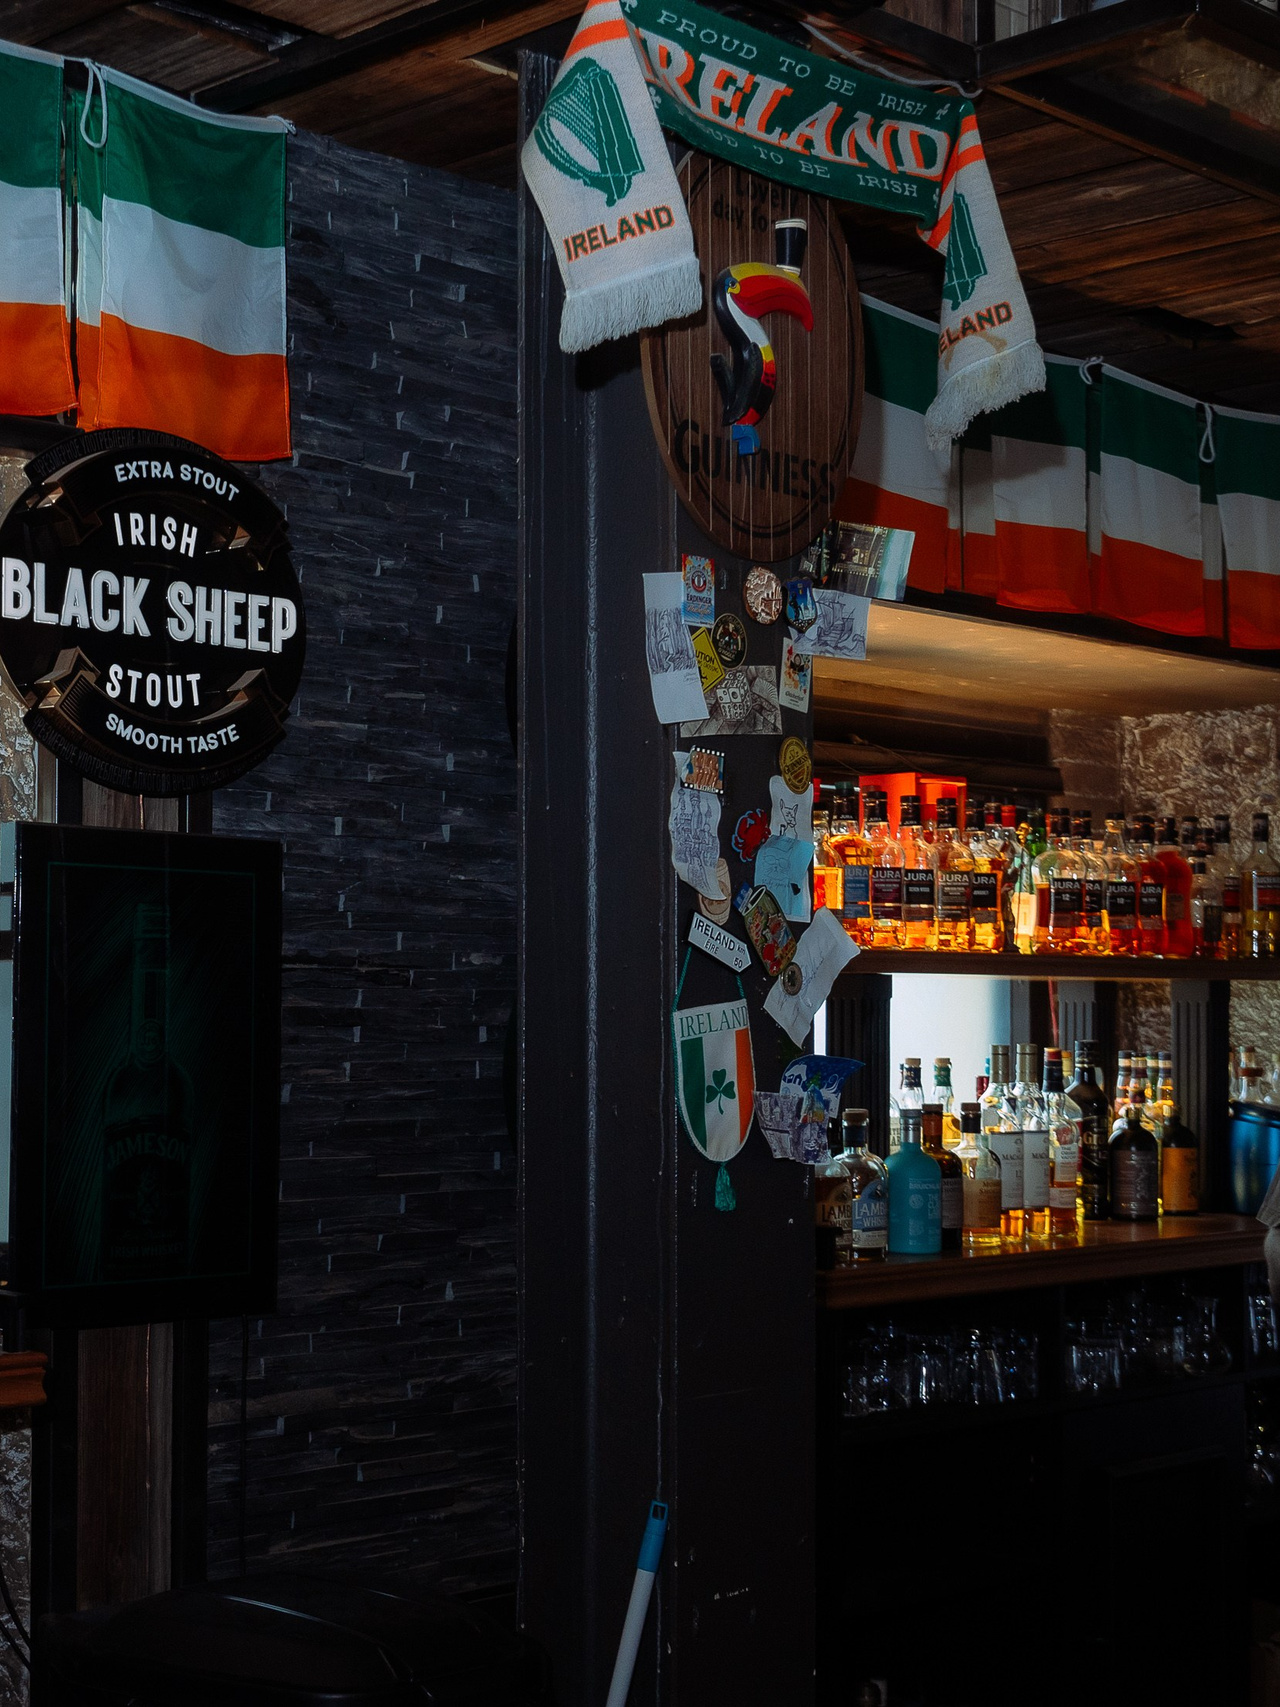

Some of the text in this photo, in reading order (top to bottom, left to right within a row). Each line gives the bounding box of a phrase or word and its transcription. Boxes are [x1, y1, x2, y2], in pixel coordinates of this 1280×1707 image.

[657, 9, 928, 116] PROUD TO BE IRISH
[753, 144, 918, 198] TO BE IRISH
[564, 205, 676, 263] IRELAND
[938, 301, 1013, 358] ELAND
[673, 418, 838, 504] GUINNESS
[114, 460, 240, 502] EXTRA STOUT
[113, 511, 199, 558] IRISH
[1, 556, 298, 654] BLACK SHEEP
[695, 649, 715, 665] UTION
[106, 663, 202, 709] STOUT
[105, 713, 241, 755] SMOOTH TASTE
[872, 870, 902, 880] JURA
[904, 872, 934, 882] JURA
[938, 872, 969, 882] JURA
[972, 875, 997, 885] URA
[1052, 881, 1080, 891] JURA
[1086, 882, 1102, 891] RA
[1107, 884, 1136, 894] JURA
[1140, 885, 1162, 895] URA
[693, 917, 736, 951] IRELAND
[733, 956, 743, 969] 50
[679, 1005, 749, 1039] IRELAND
[821, 1204, 852, 1223] LAMB
[855, 1201, 888, 1219] LAMB
[862, 1217, 888, 1228] WHIS
